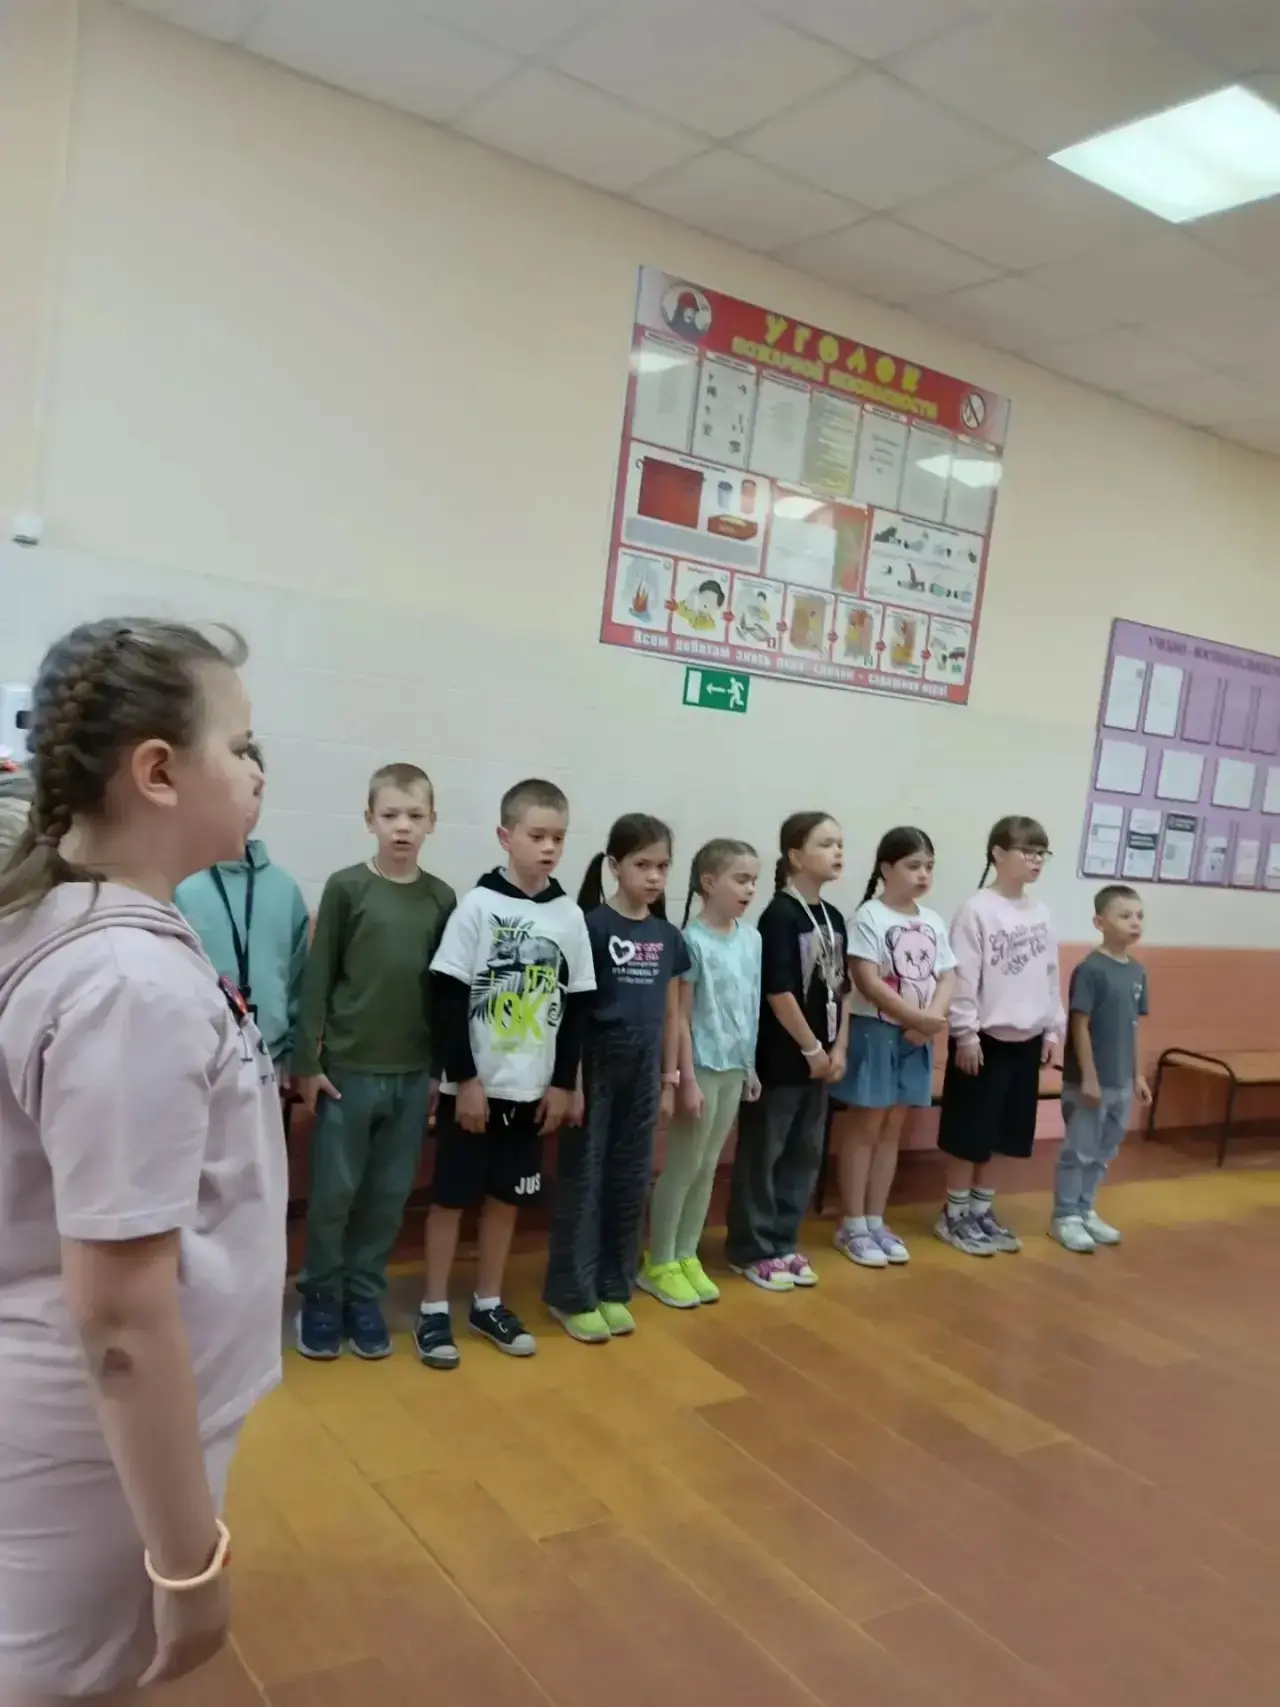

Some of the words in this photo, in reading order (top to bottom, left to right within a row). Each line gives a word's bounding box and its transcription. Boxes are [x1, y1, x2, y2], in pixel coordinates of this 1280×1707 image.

[731, 335, 825, 383] ПОЖАРНОЙ
[764, 313, 922, 393] УГОЛОК
[493, 991, 549, 1044] OK
